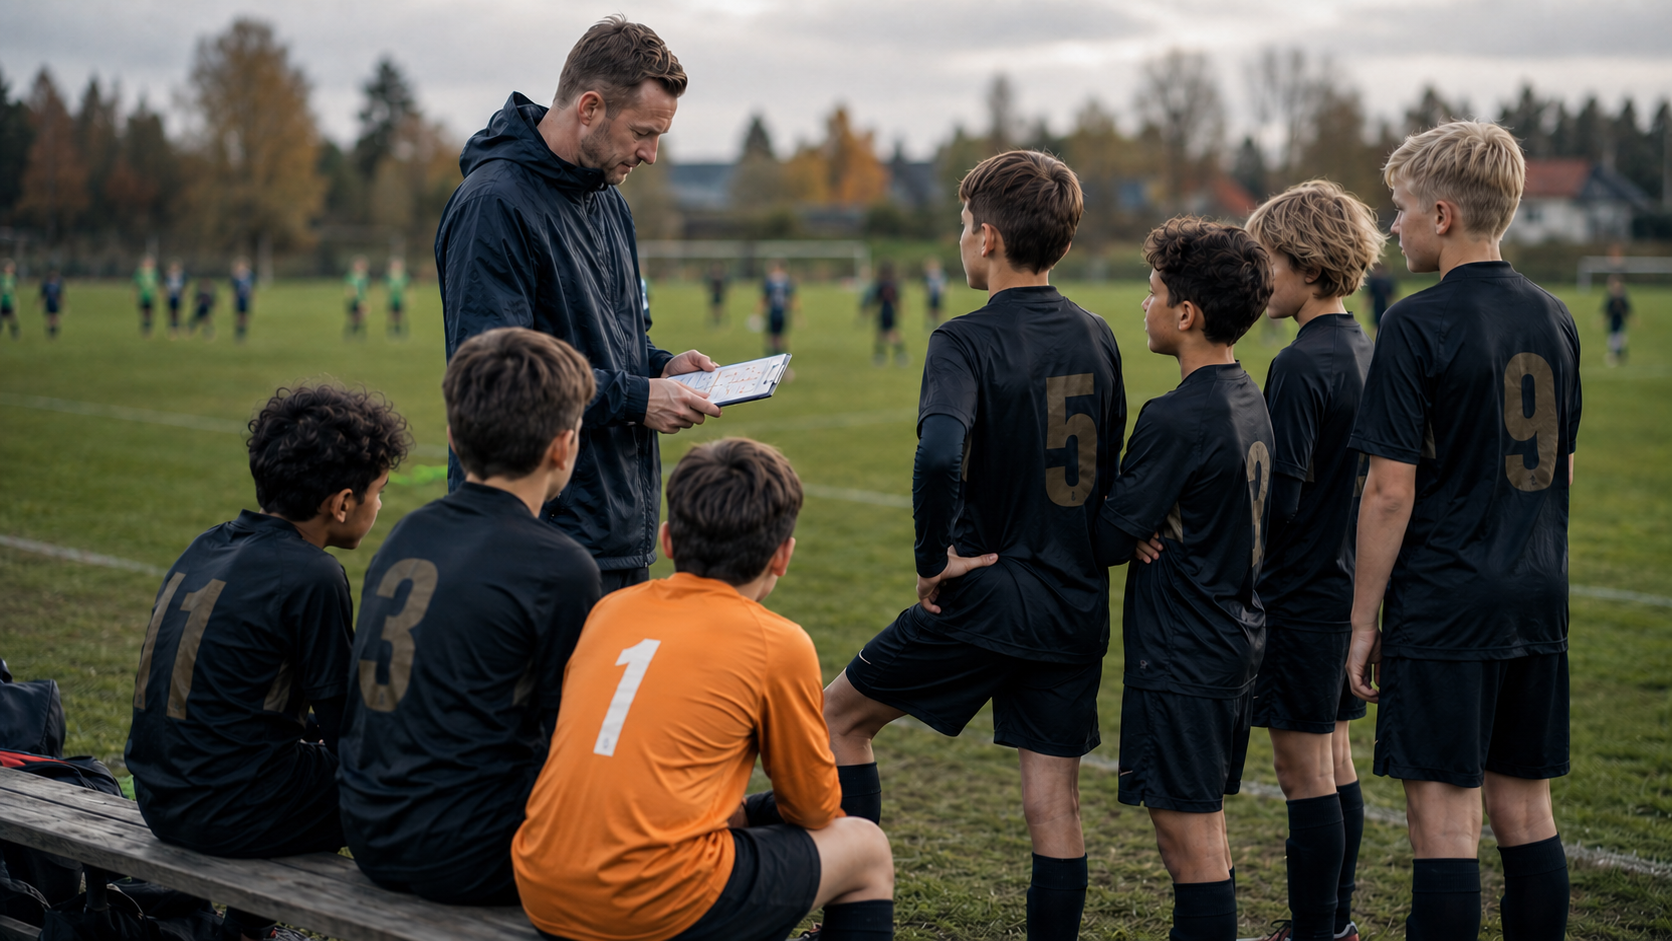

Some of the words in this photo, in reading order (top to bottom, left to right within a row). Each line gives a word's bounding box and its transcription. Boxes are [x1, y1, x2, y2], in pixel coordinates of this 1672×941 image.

[1046, 373, 1097, 507] 5
[1504, 352, 1558, 492] 9
[134, 571, 227, 720] 11
[359, 558, 438, 712] 3
[593, 638, 661, 757] 1
